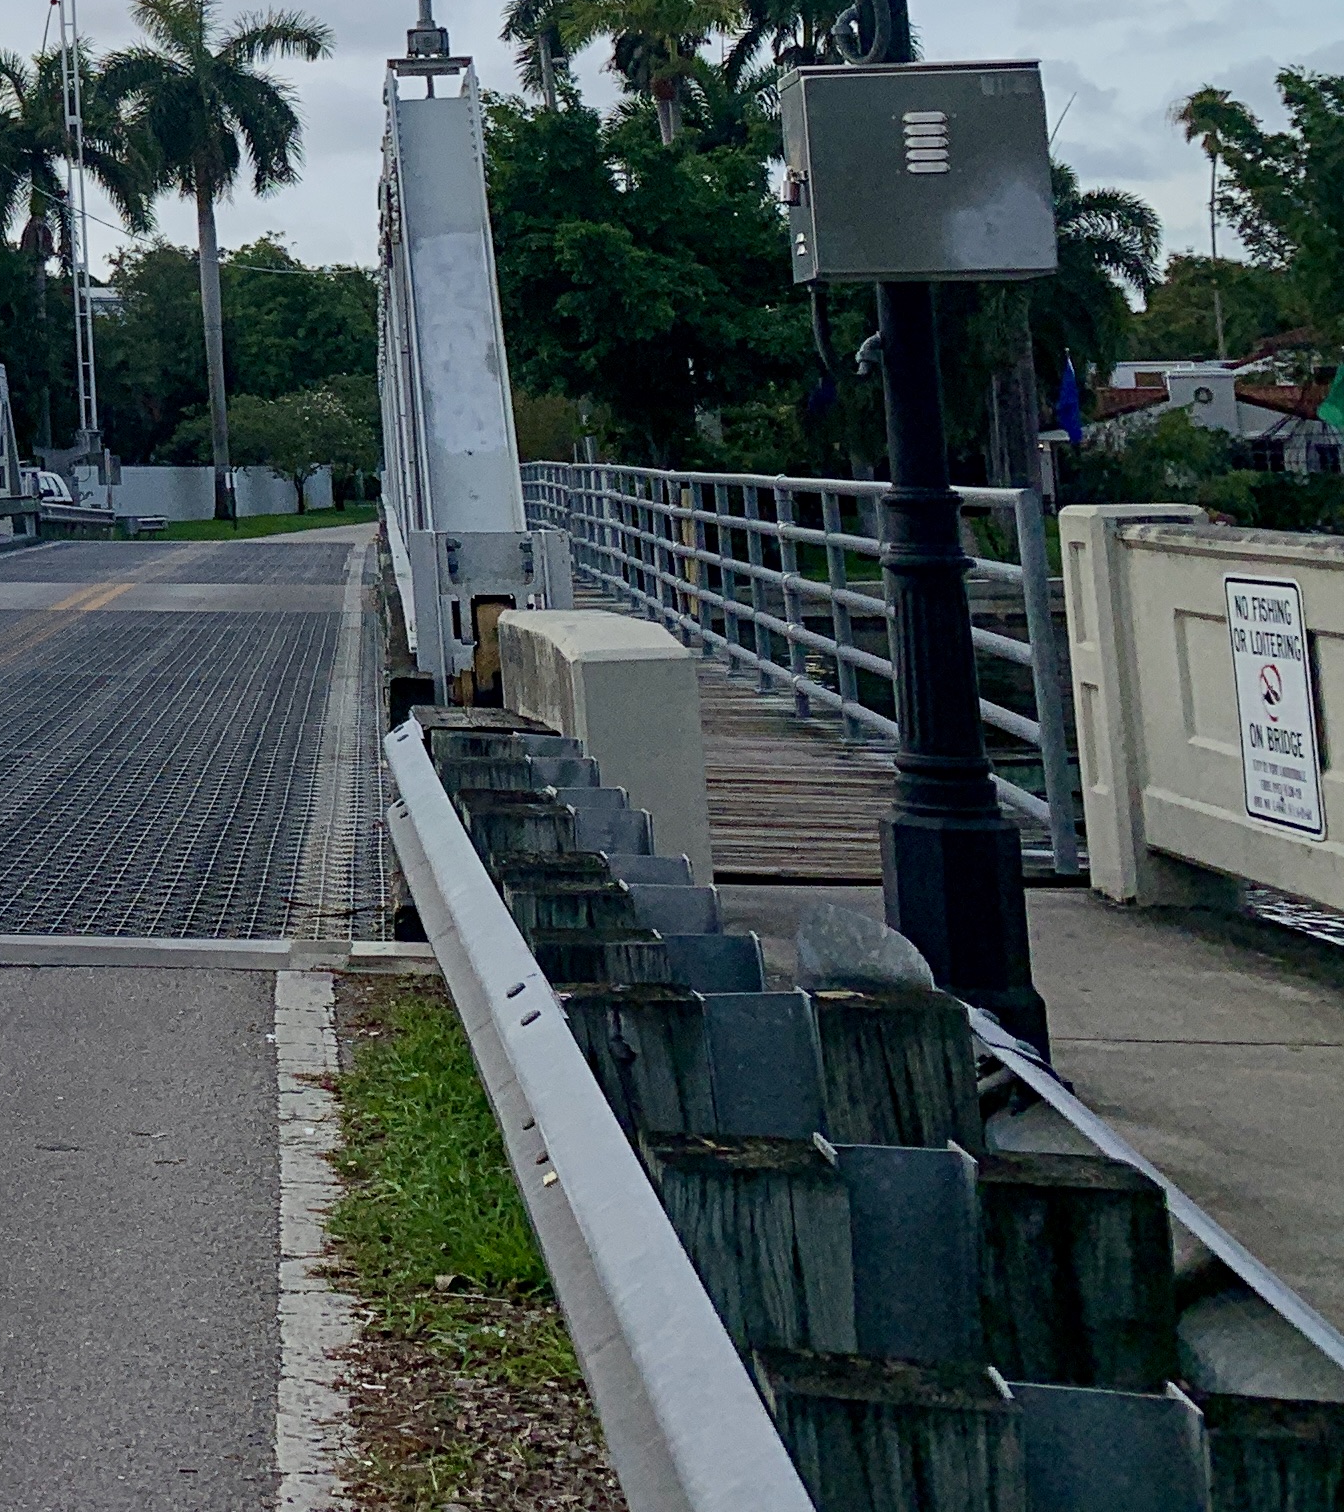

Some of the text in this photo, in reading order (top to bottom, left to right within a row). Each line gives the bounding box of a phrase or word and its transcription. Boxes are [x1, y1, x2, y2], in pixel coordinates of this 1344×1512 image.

[1234, 594, 1292, 626] NO FISHING
[1233, 627, 1302, 662] OR LOITERING
[1249, 722, 1305, 759] ON BRIDGE
